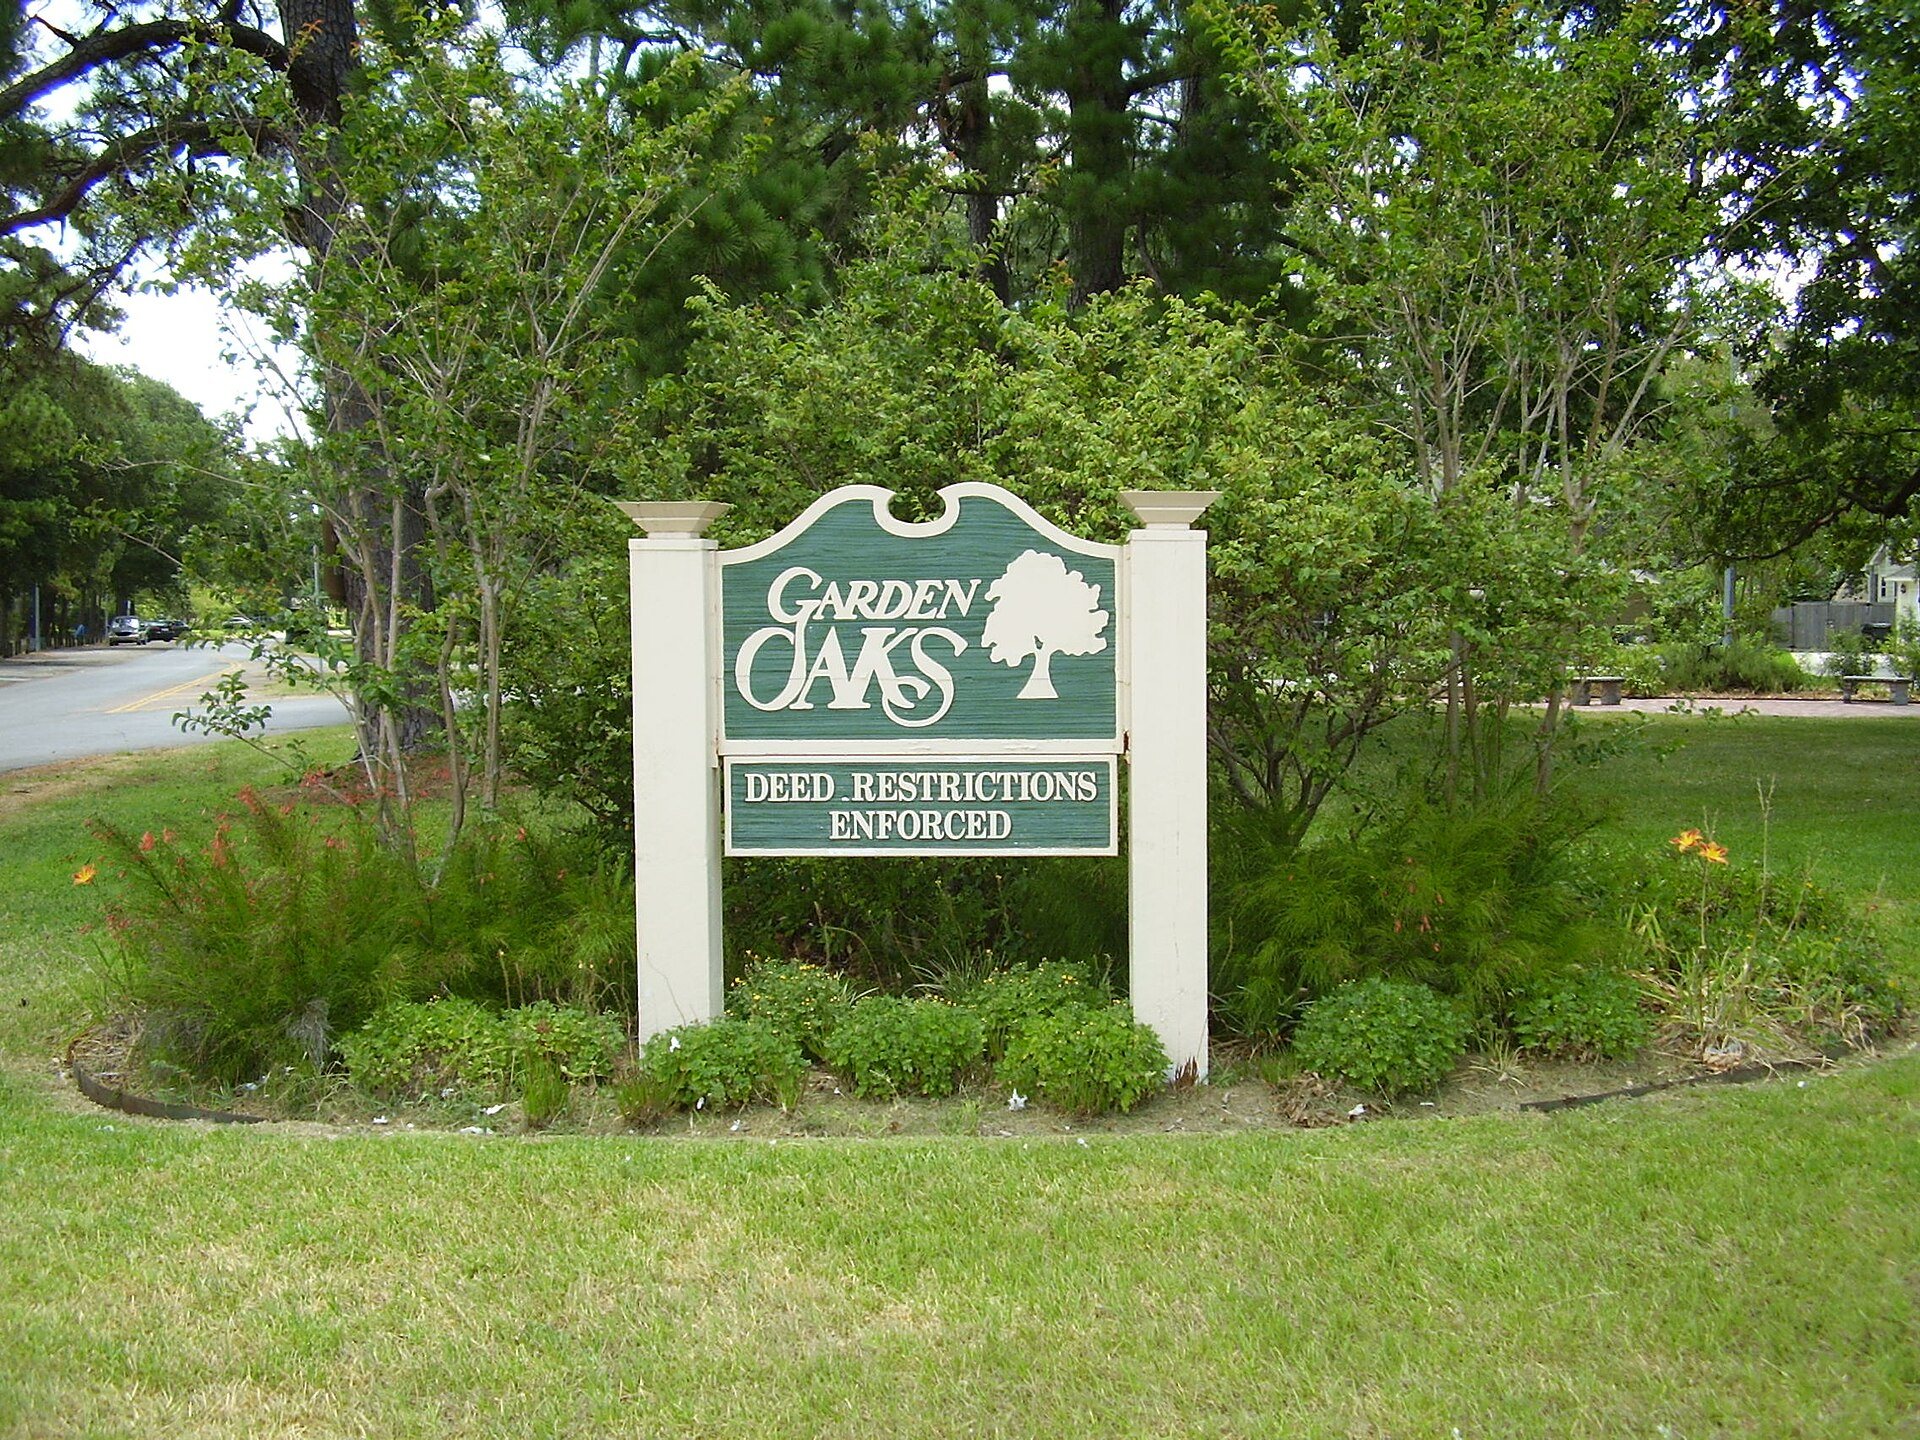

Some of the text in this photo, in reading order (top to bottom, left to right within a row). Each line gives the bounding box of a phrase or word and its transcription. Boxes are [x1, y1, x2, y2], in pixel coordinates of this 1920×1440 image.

[767, 566, 982, 624] GARDEN
[734, 626, 968, 727] OAKS
[745, 771, 1097, 802] DEED RESTRICTIONS
[829, 810, 1012, 840] ENFORCED
